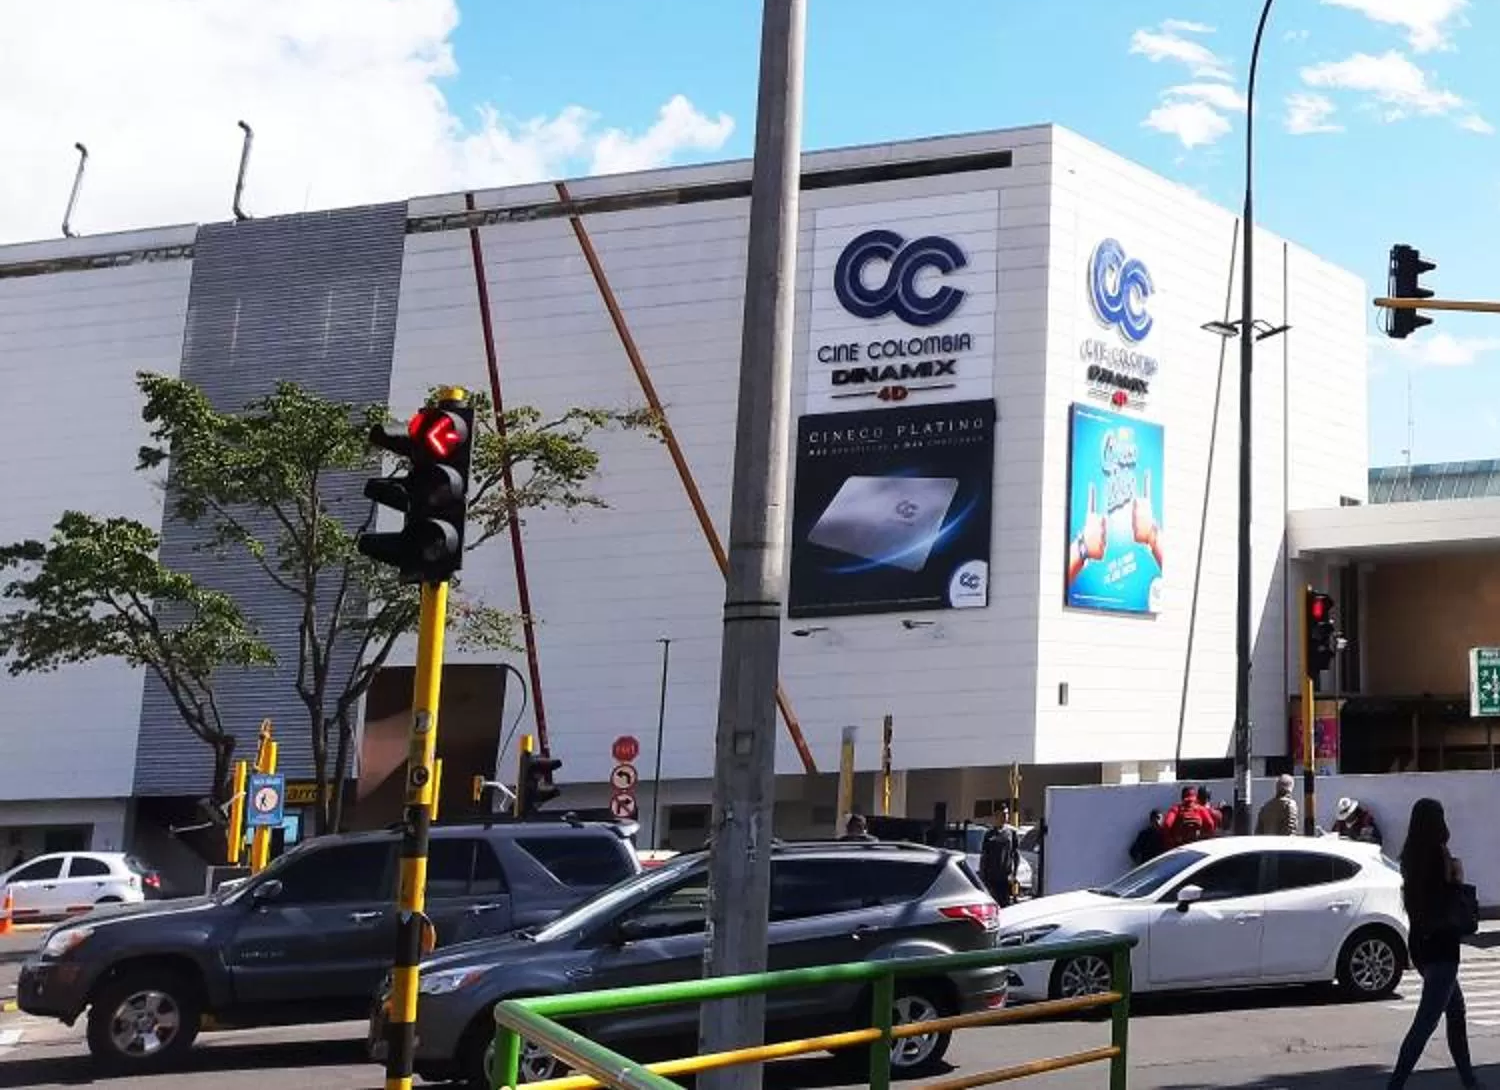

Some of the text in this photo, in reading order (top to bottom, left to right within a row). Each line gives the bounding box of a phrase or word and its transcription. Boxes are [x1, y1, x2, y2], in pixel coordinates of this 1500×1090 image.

[817, 333, 972, 363] CINE COLOMBIA
[831, 360, 957, 385] DINAMIX
[877, 385, 909, 401] 4D
[809, 427, 884, 443] CINECO
[896, 418, 984, 437] PLATINO
